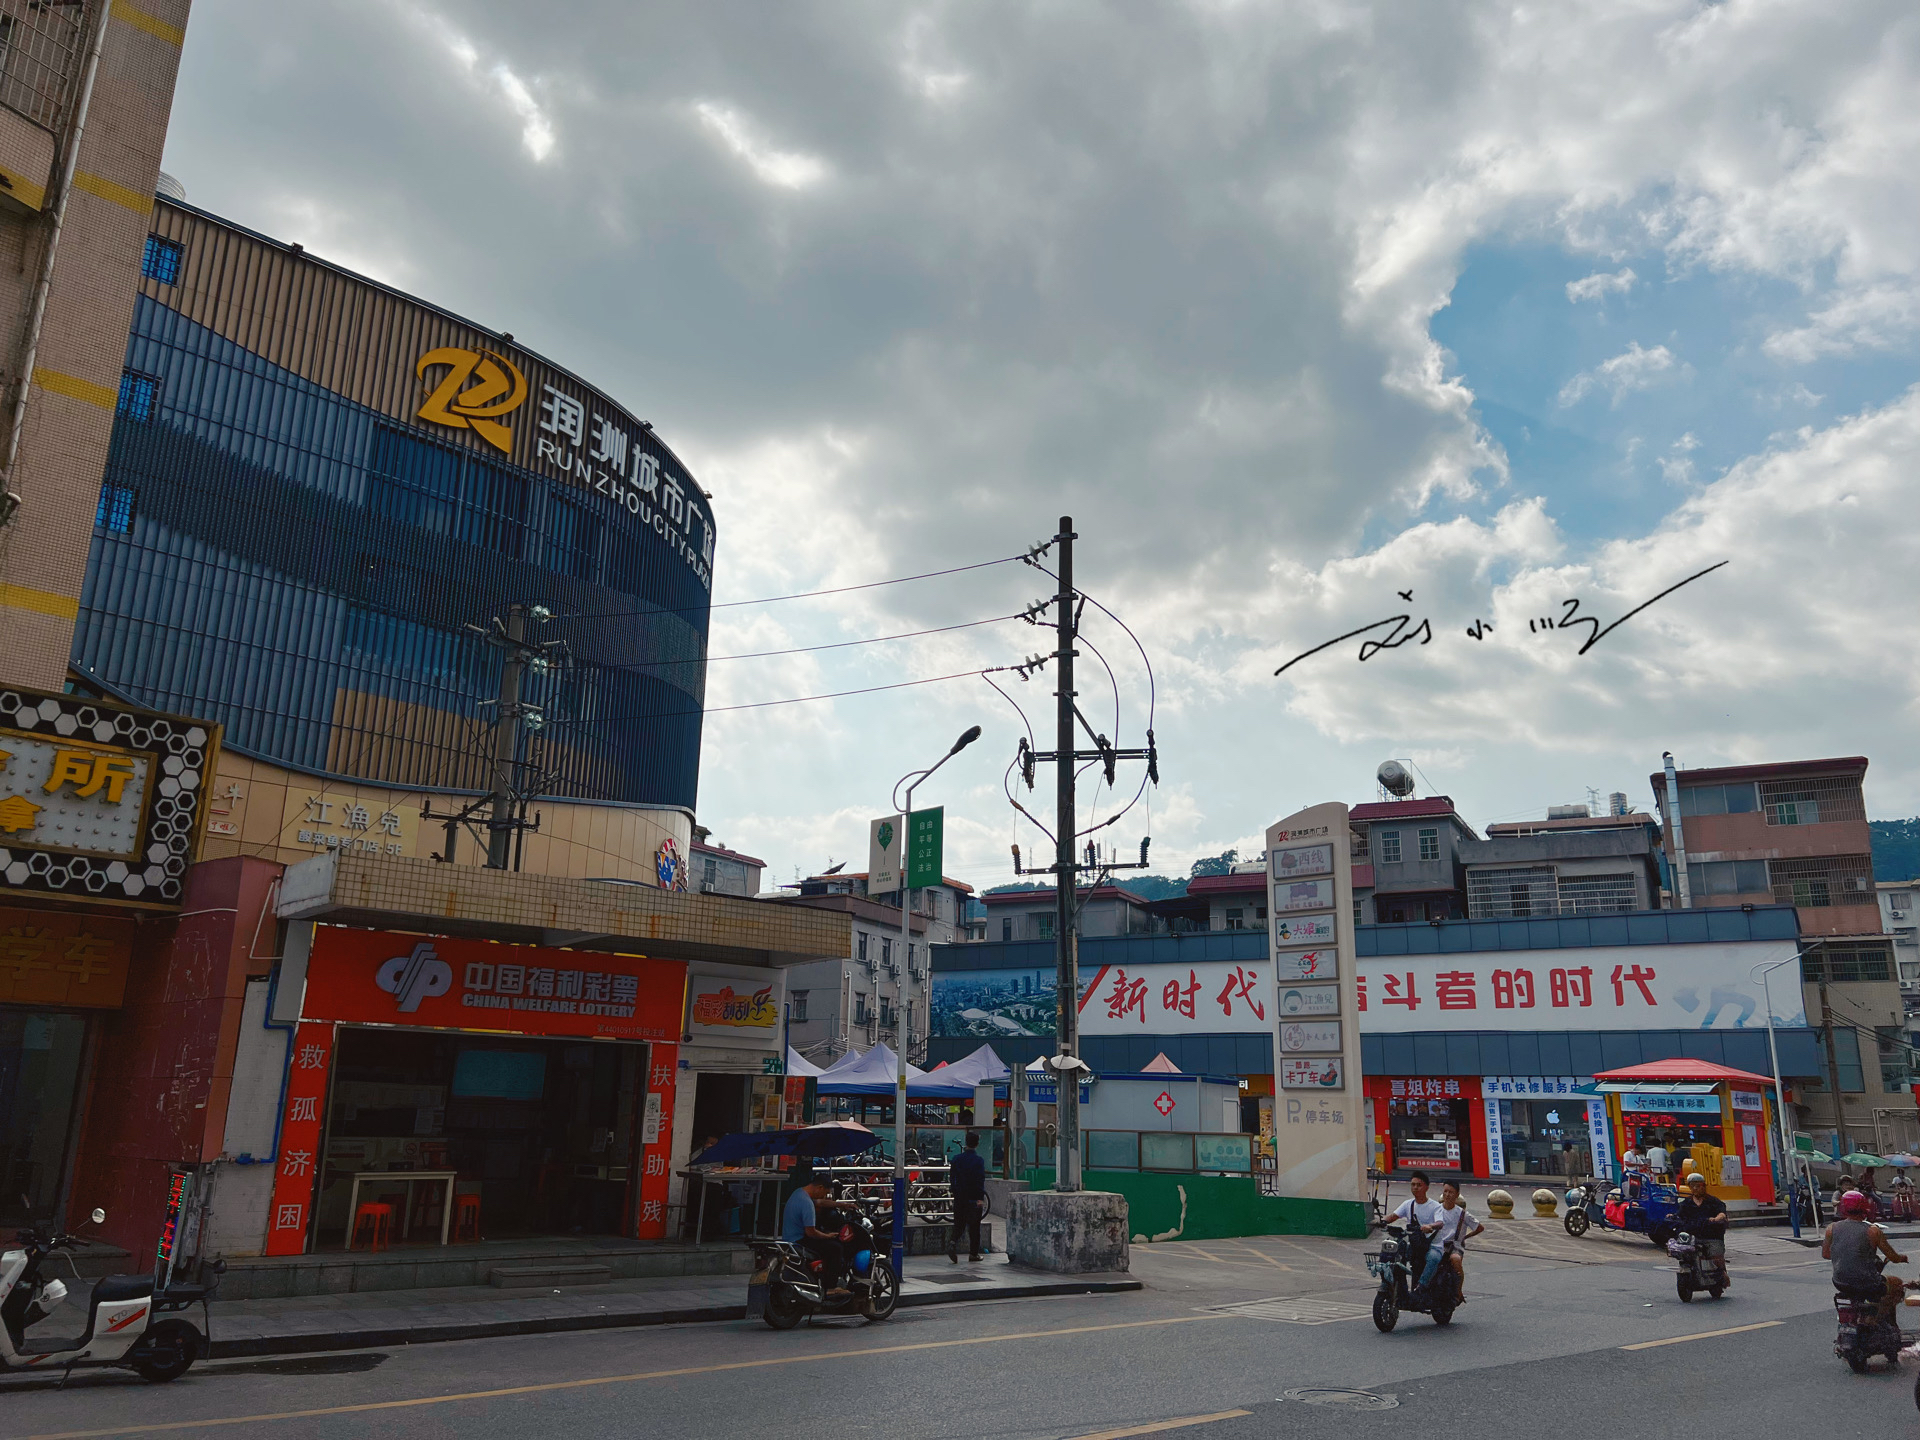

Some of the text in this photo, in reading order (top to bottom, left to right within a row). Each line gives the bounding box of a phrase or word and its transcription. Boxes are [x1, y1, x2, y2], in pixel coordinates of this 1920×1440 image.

[536, 437, 652, 524] RUNZHOU
[653, 514, 687, 556] CITY
[0, 748, 135, 803] 所
[464, 962, 638, 1004] 中国福利彩票
[1103, 965, 1265, 1023] 新时代
[1356, 965, 1658, 1012] 斗者的时代
[462, 993, 637, 1018] CHINA WELFARE LOTTERY
[1286, 1071, 1319, 1084] 卡丁车
[1390, 1078, 1460, 1096] 喜姐炸串
[1306, 1109, 1344, 1125] 停车场
[1592, 1103, 1604, 1136] 手机换屏
[1649, 1098, 1706, 1109] 中国体育彩票
[275, 1043, 327, 1231] 救孤济困
